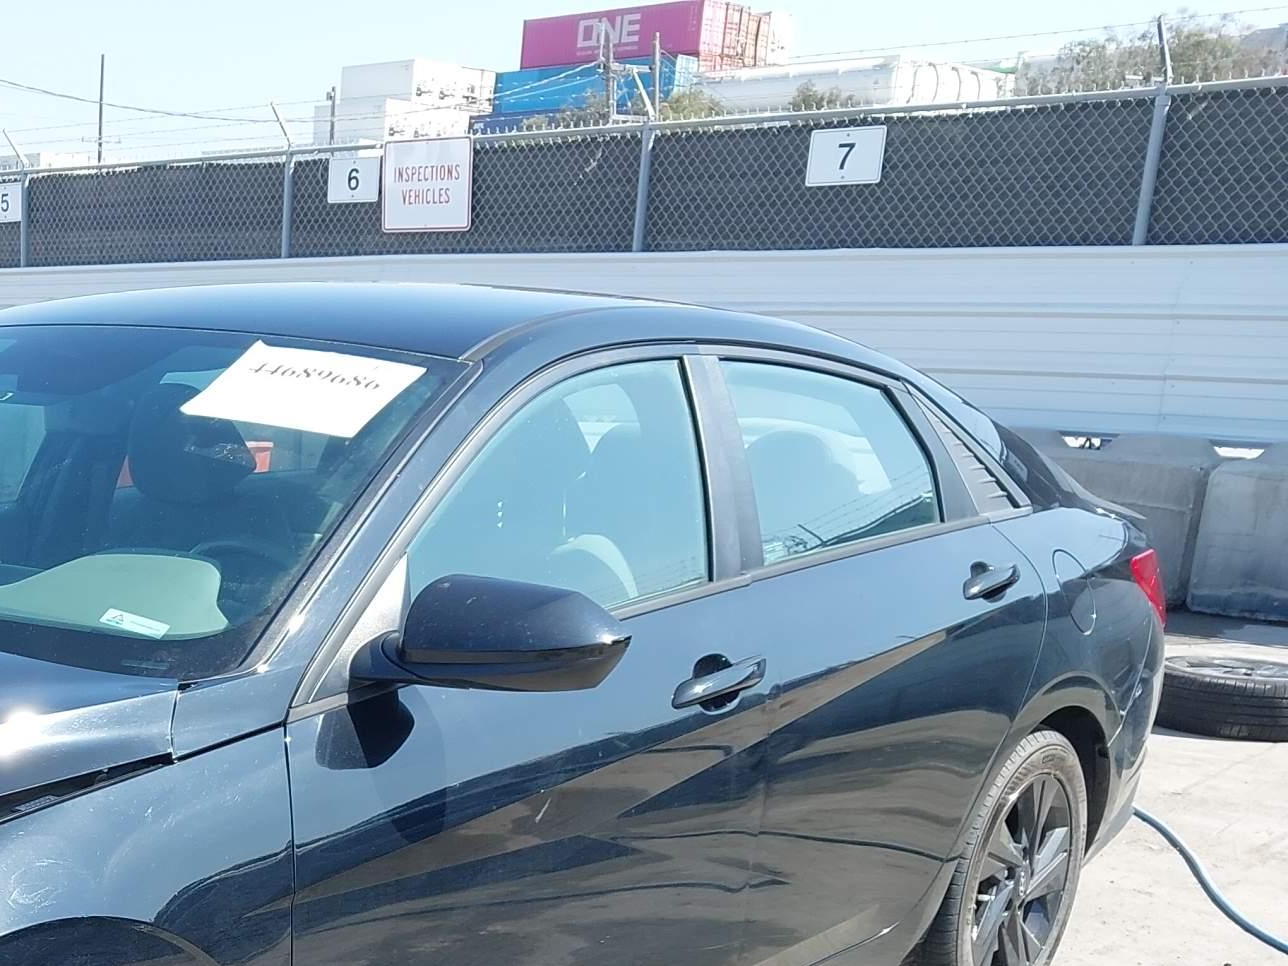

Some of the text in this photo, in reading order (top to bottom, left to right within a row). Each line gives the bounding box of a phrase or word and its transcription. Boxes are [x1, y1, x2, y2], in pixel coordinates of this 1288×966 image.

[576, 12, 641, 48] ONE
[838, 142, 856, 170] 7
[348, 168, 360, 191] 6
[393, 163, 461, 183] INSPECTIONS
[1, 193, 9, 212] 5
[401, 187, 451, 206] VEHICLES
[248, 362, 381, 390] 44689686
